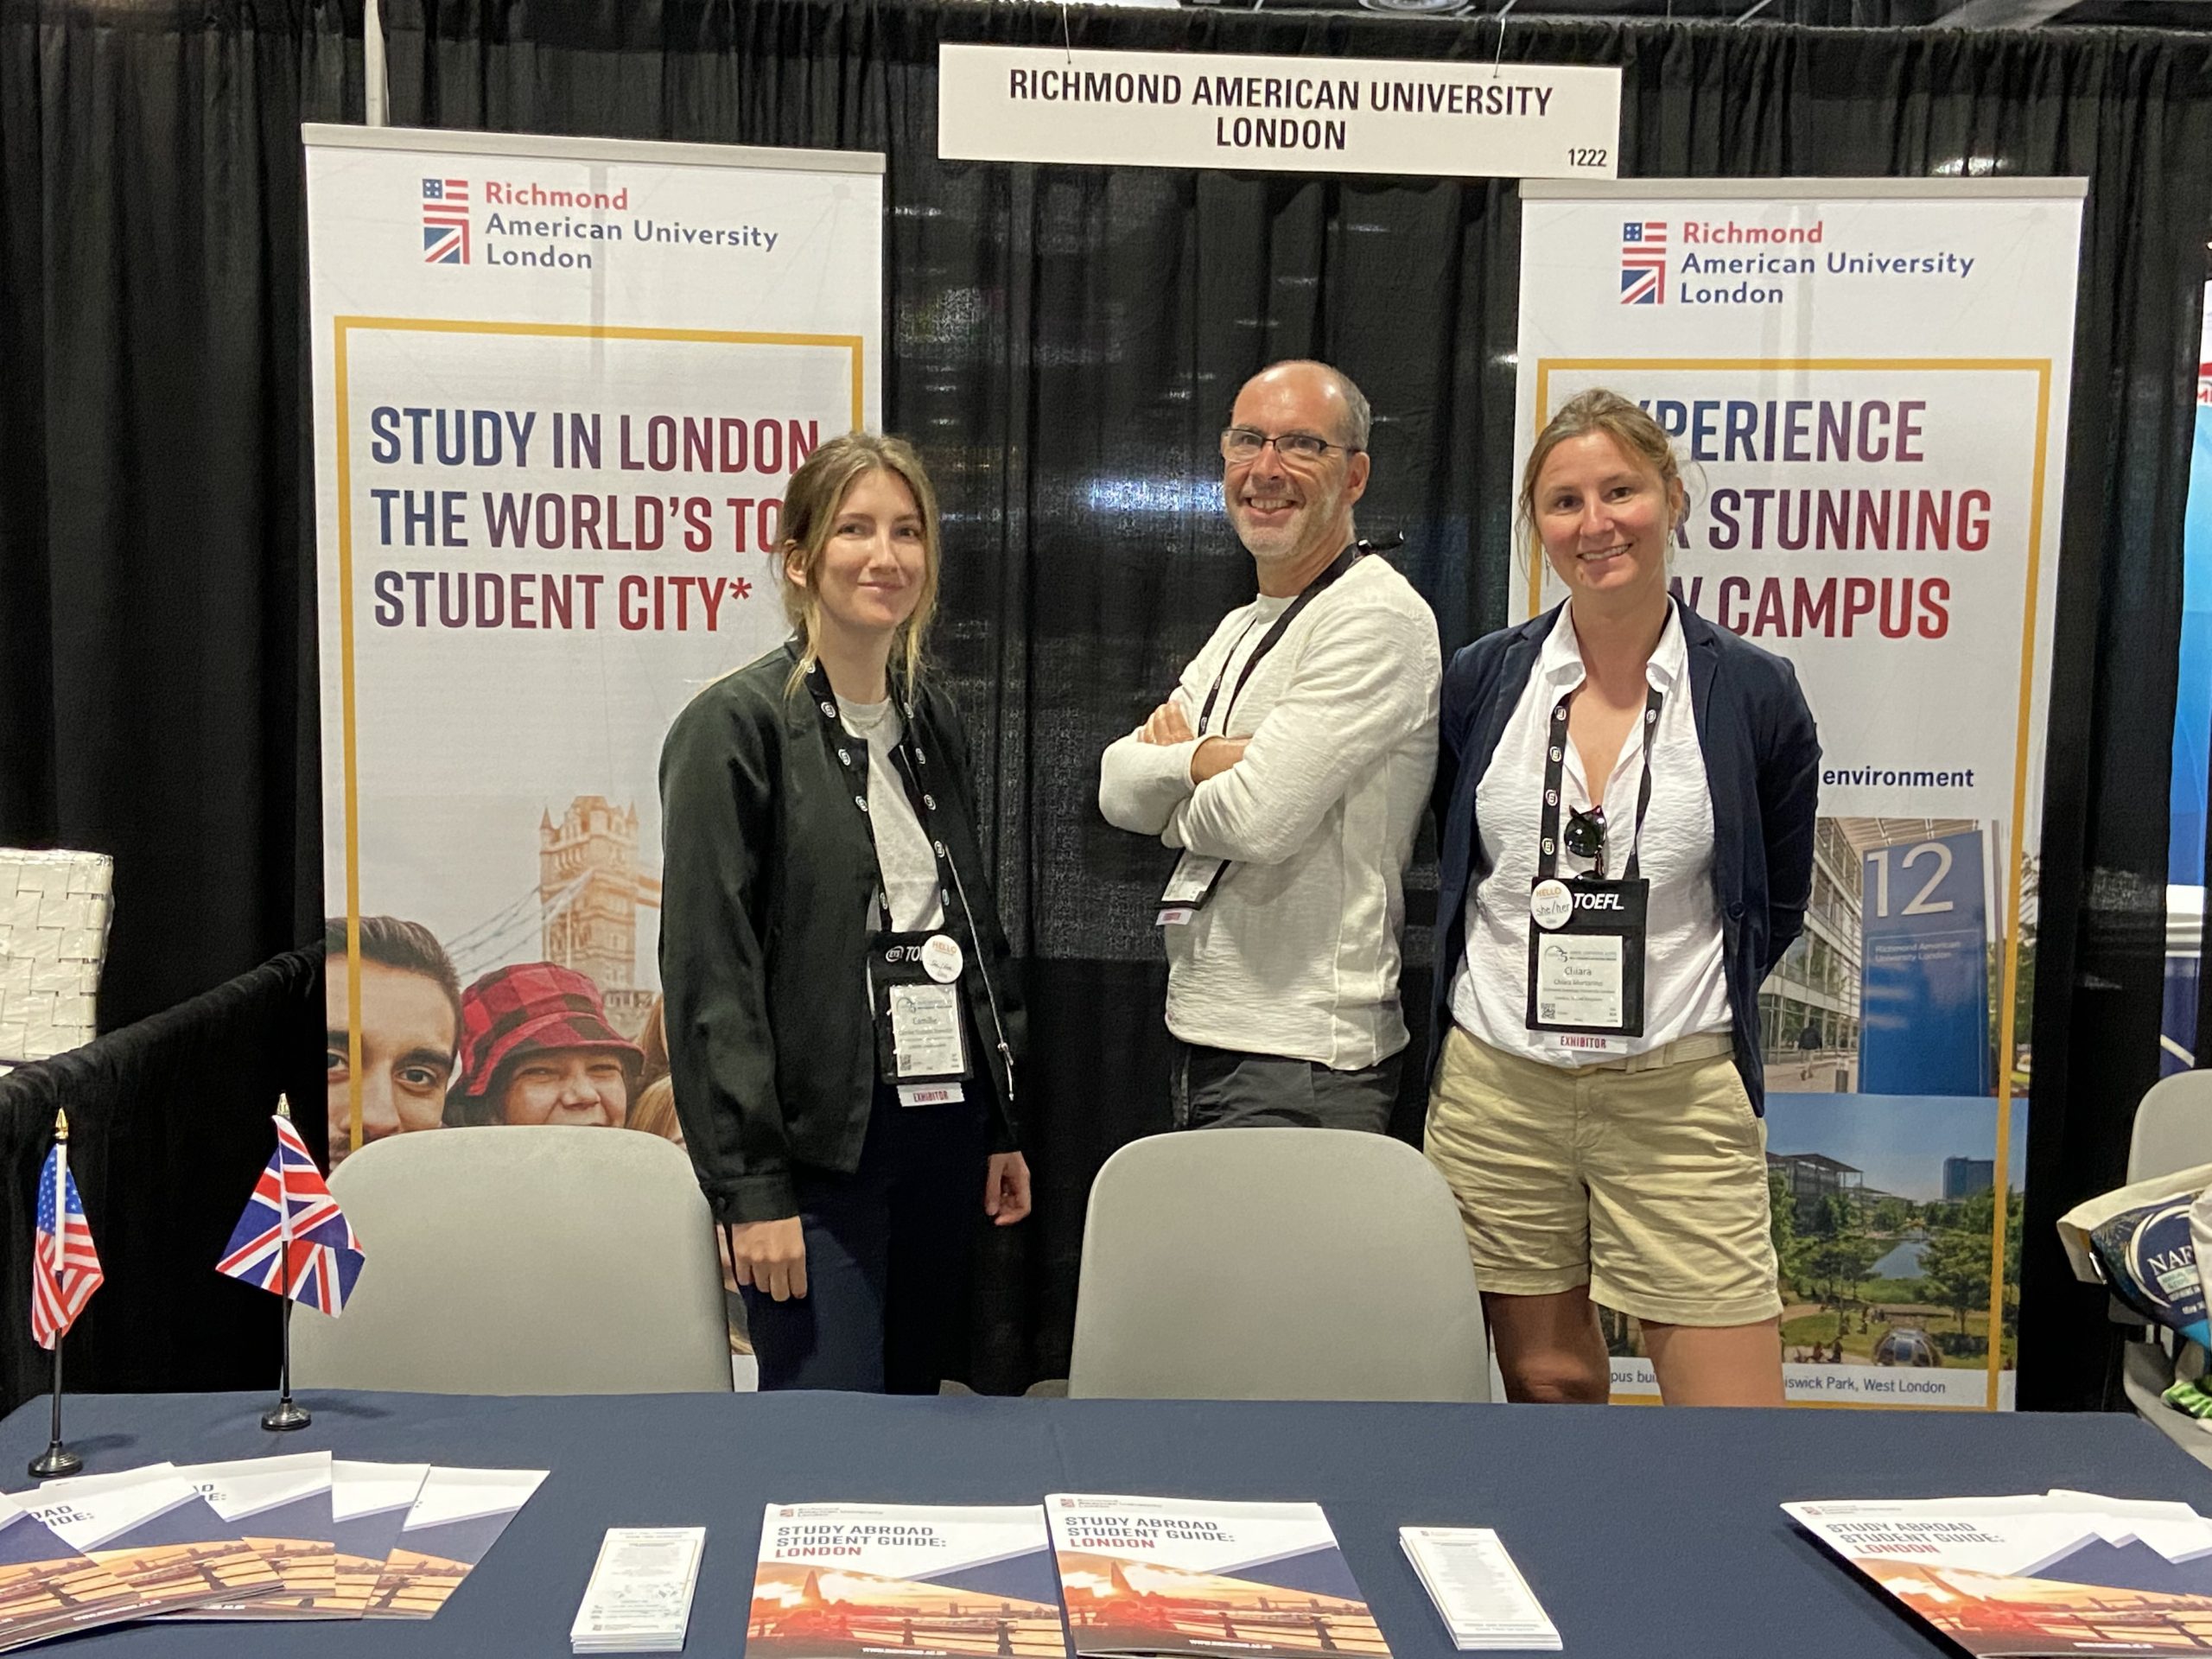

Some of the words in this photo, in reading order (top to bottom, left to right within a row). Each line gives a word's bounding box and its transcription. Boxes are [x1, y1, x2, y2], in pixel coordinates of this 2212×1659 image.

[1008, 69, 1183, 105] RICHMOND
[1191, 75, 1360, 111] AMERICAN
[1370, 81, 1554, 117] UNIVERSITY
[1216, 117, 1347, 151] LONDON
[1567, 148, 1607, 168] 1222
[486, 181, 629, 211] Richmond
[485, 213, 623, 241] American
[633, 220, 779, 253] University
[1683, 221, 1823, 244] Richmond
[486, 243, 593, 270] London
[1681, 252, 1815, 275] American
[1827, 251, 1976, 278] University
[1680, 283, 1784, 304] London
[371, 405, 537, 467] STUDY
[553, 412, 601, 470] IN
[620, 415, 819, 475] LONDON
[1638, 400, 1927, 463] PERIENCE
[372, 488, 468, 548] THE
[727, 498, 785, 554] TO
[1708, 488, 1992, 552] STUNNING
[373, 569, 604, 629] STUDENT
[1717, 576, 1951, 639] CAMPUS
[1822, 766, 1974, 788] environment
[1866, 842, 1954, 918] 12
[1573, 893, 1625, 910] TOEFL
[1560, 1036, 1607, 1049] EXHIBITOR
[912, 1090, 949, 1103] EXHIBITOR
[2146, 1244, 2193, 1276] NAF
[1611, 1372, 1633, 1383] pus
[1784, 1376, 1823, 1389] iswick
[1826, 1376, 1859, 1392] Park,
[1863, 1378, 1895, 1393] West
[1898, 1379, 1946, 1394] London
[48, 1511, 96, 1528] IDE:
[1065, 1516, 1130, 1527] STUDY
[1135, 1518, 1218, 1531] ABROAD
[1825, 1522, 1891, 1534] STUDY
[1895, 1522, 1977, 1532] ABROAD
[778, 1525, 846, 1536] STUDY
[849, 1525, 934, 1536] ABROAD
[1067, 1527, 1160, 1538] STUDENT
[1165, 1529, 1236, 1542] GUIDE:
[1840, 1533, 1935, 1544] STUDENT
[1933, 1533, 2006, 1543] GUIDE:
[776, 1535, 872, 1547] STUDENT
[877, 1536, 947, 1548] GUIDE:
[1070, 1538, 1156, 1548] LONDON
[1853, 1543, 1942, 1554] LONDON
[774, 1547, 862, 1558] LONDON
